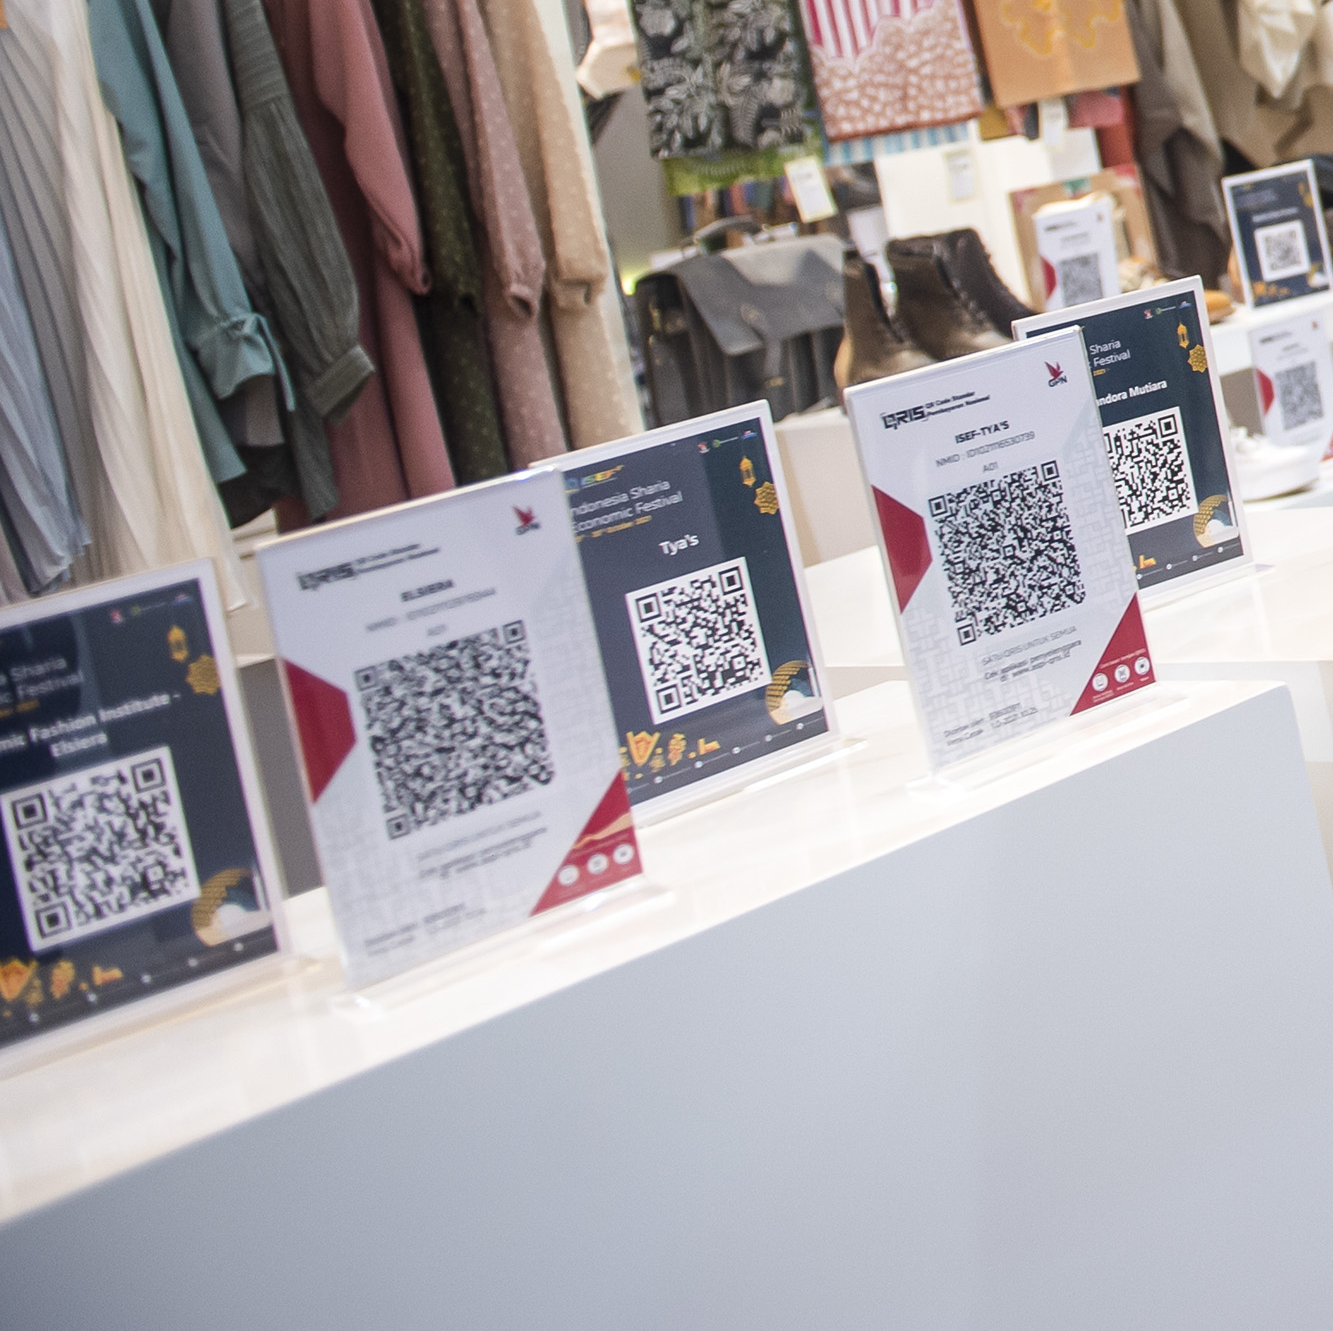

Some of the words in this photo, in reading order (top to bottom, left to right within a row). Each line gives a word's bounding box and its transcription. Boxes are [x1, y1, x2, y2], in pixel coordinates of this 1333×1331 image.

[1089, 339, 1121, 355] Sharia
[1093, 349, 1131, 367] Festival
[1129, 380, 1168, 398] Mutiara
[882, 406, 926, 429] QRIS
[630, 480, 671, 500] Sharia
[635, 490, 683, 514] Festival
[659, 534, 699, 555] Tya's
[29, 715, 97, 743] Fashion
[98, 694, 171, 722] Institute
